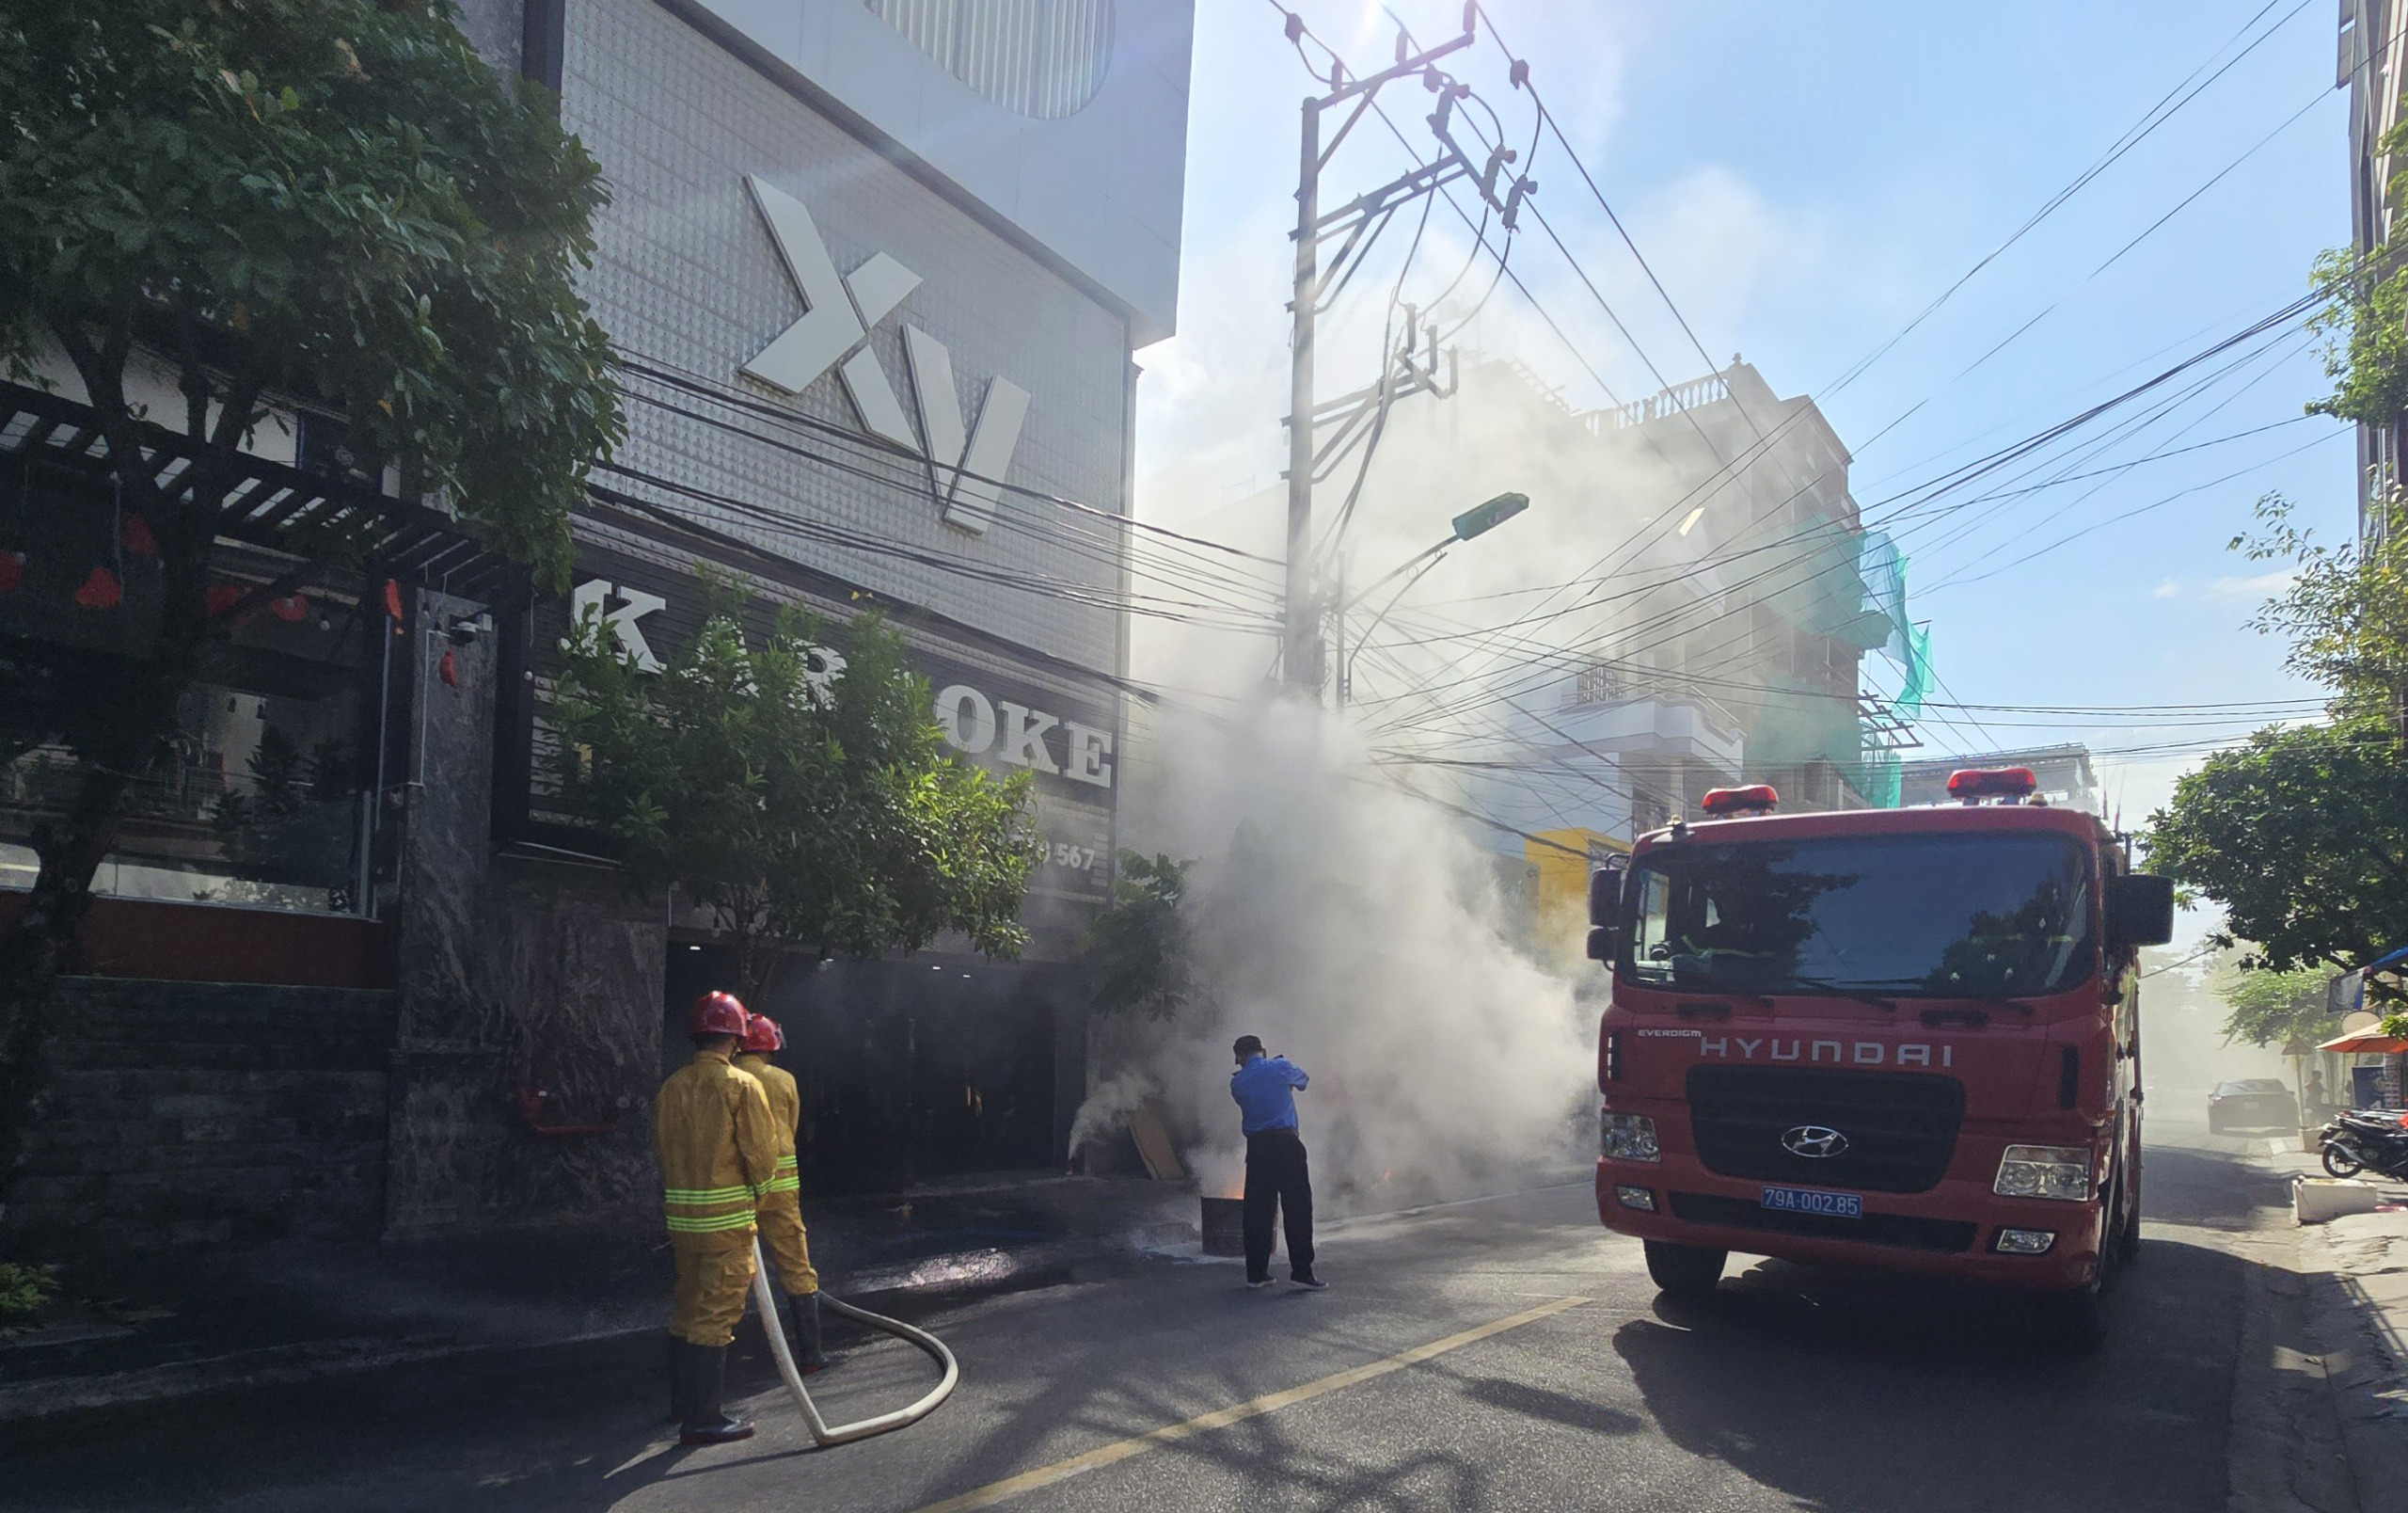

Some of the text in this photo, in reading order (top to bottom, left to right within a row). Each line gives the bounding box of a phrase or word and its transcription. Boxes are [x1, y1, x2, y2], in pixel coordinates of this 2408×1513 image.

[1054, 842, 1095, 871] 567
[1700, 1036, 1952, 1067] HYUNDAI
[1764, 1188, 1859, 1216] 79A-002.85
